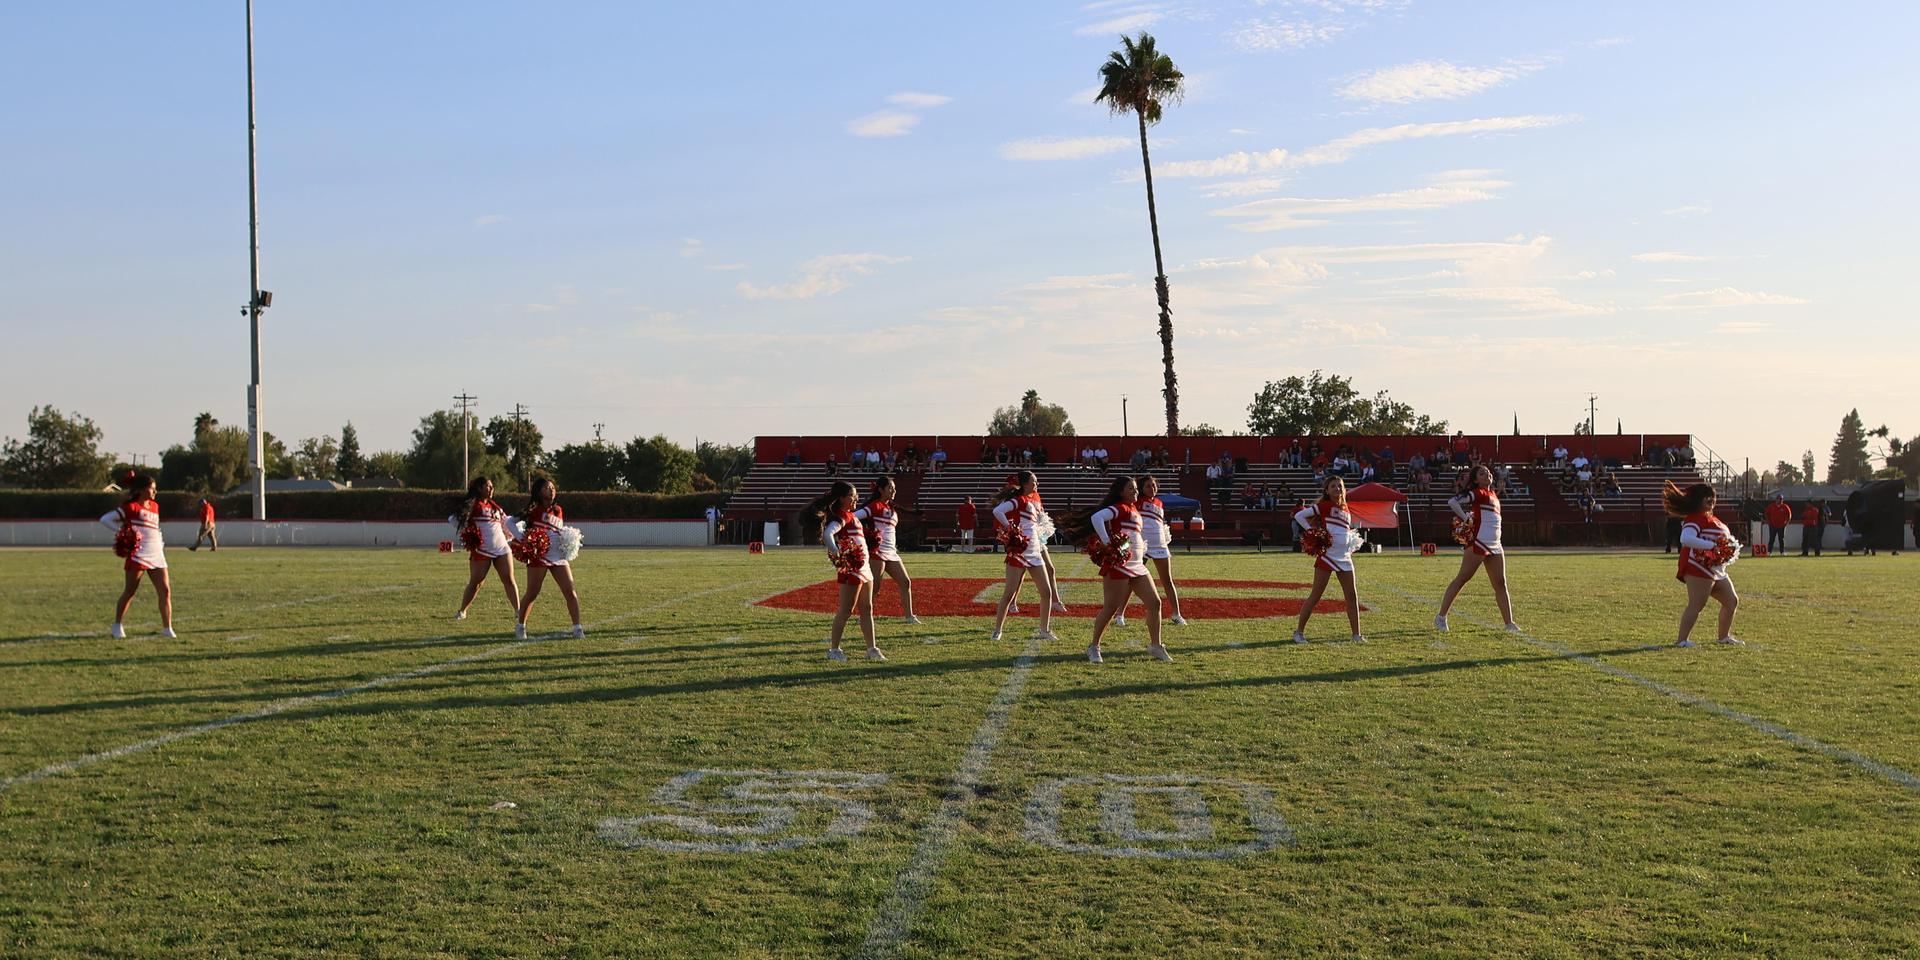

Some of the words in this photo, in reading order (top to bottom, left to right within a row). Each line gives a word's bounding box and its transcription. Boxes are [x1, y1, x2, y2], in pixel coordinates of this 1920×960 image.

[440, 541, 452, 552] 30
[750, 542, 762, 553] 40
[1423, 544, 1436, 554] 40
[1754, 544, 1767, 555] 30
